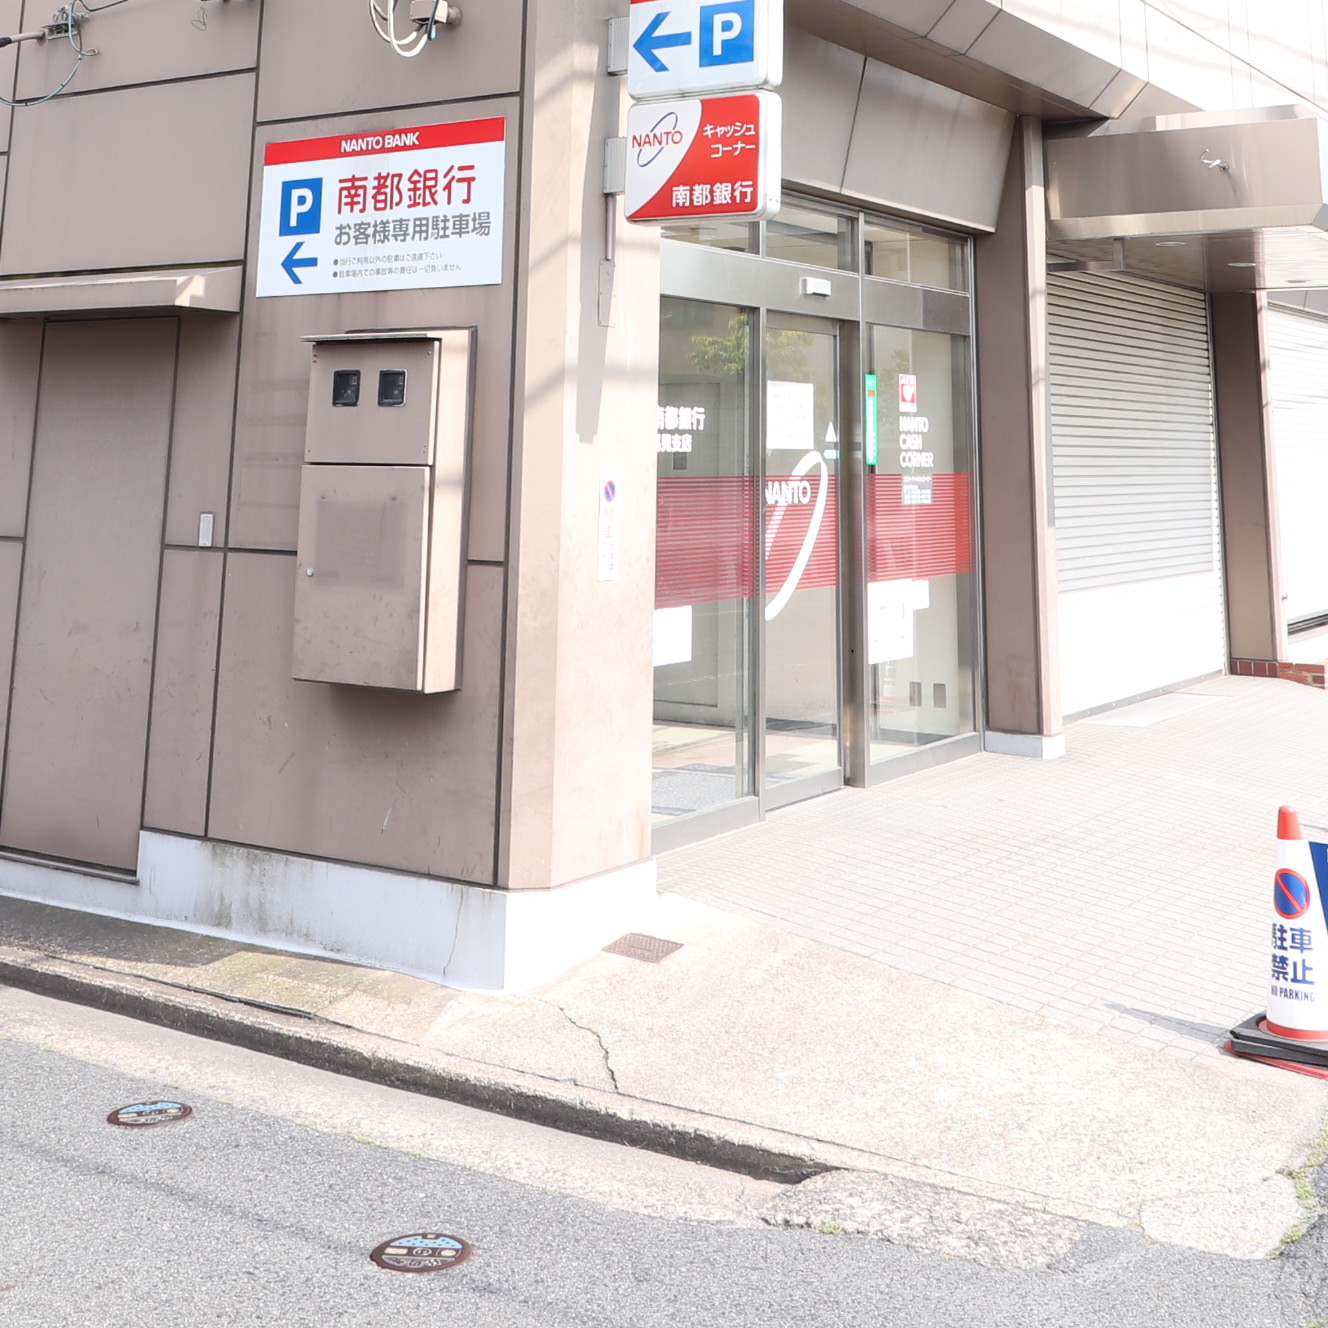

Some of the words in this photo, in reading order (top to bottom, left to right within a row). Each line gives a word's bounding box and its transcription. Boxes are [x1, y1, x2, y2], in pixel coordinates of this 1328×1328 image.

[713, 11, 742, 56] P
[632, 130, 683, 149] NANTO
[703, 121, 756, 139] キャッシュ
[340, 135, 383, 153] NANTO
[384, 131, 420, 149] BANK
[710, 140, 756, 158] コーナー
[337, 164, 476, 215] 南都銀行
[672, 180, 754, 208] 南都銀行
[289, 187, 314, 227] P
[334, 211, 492, 247] お客様専用駐車場
[899, 416, 929, 433] NANTO
[899, 433, 923, 450] CASH
[899, 452, 934, 468] CORNER
[1272, 923, 1313, 954] 駐車
[1271, 953, 1315, 985] 禁止
[1279, 987, 1315, 1003] PARKING
